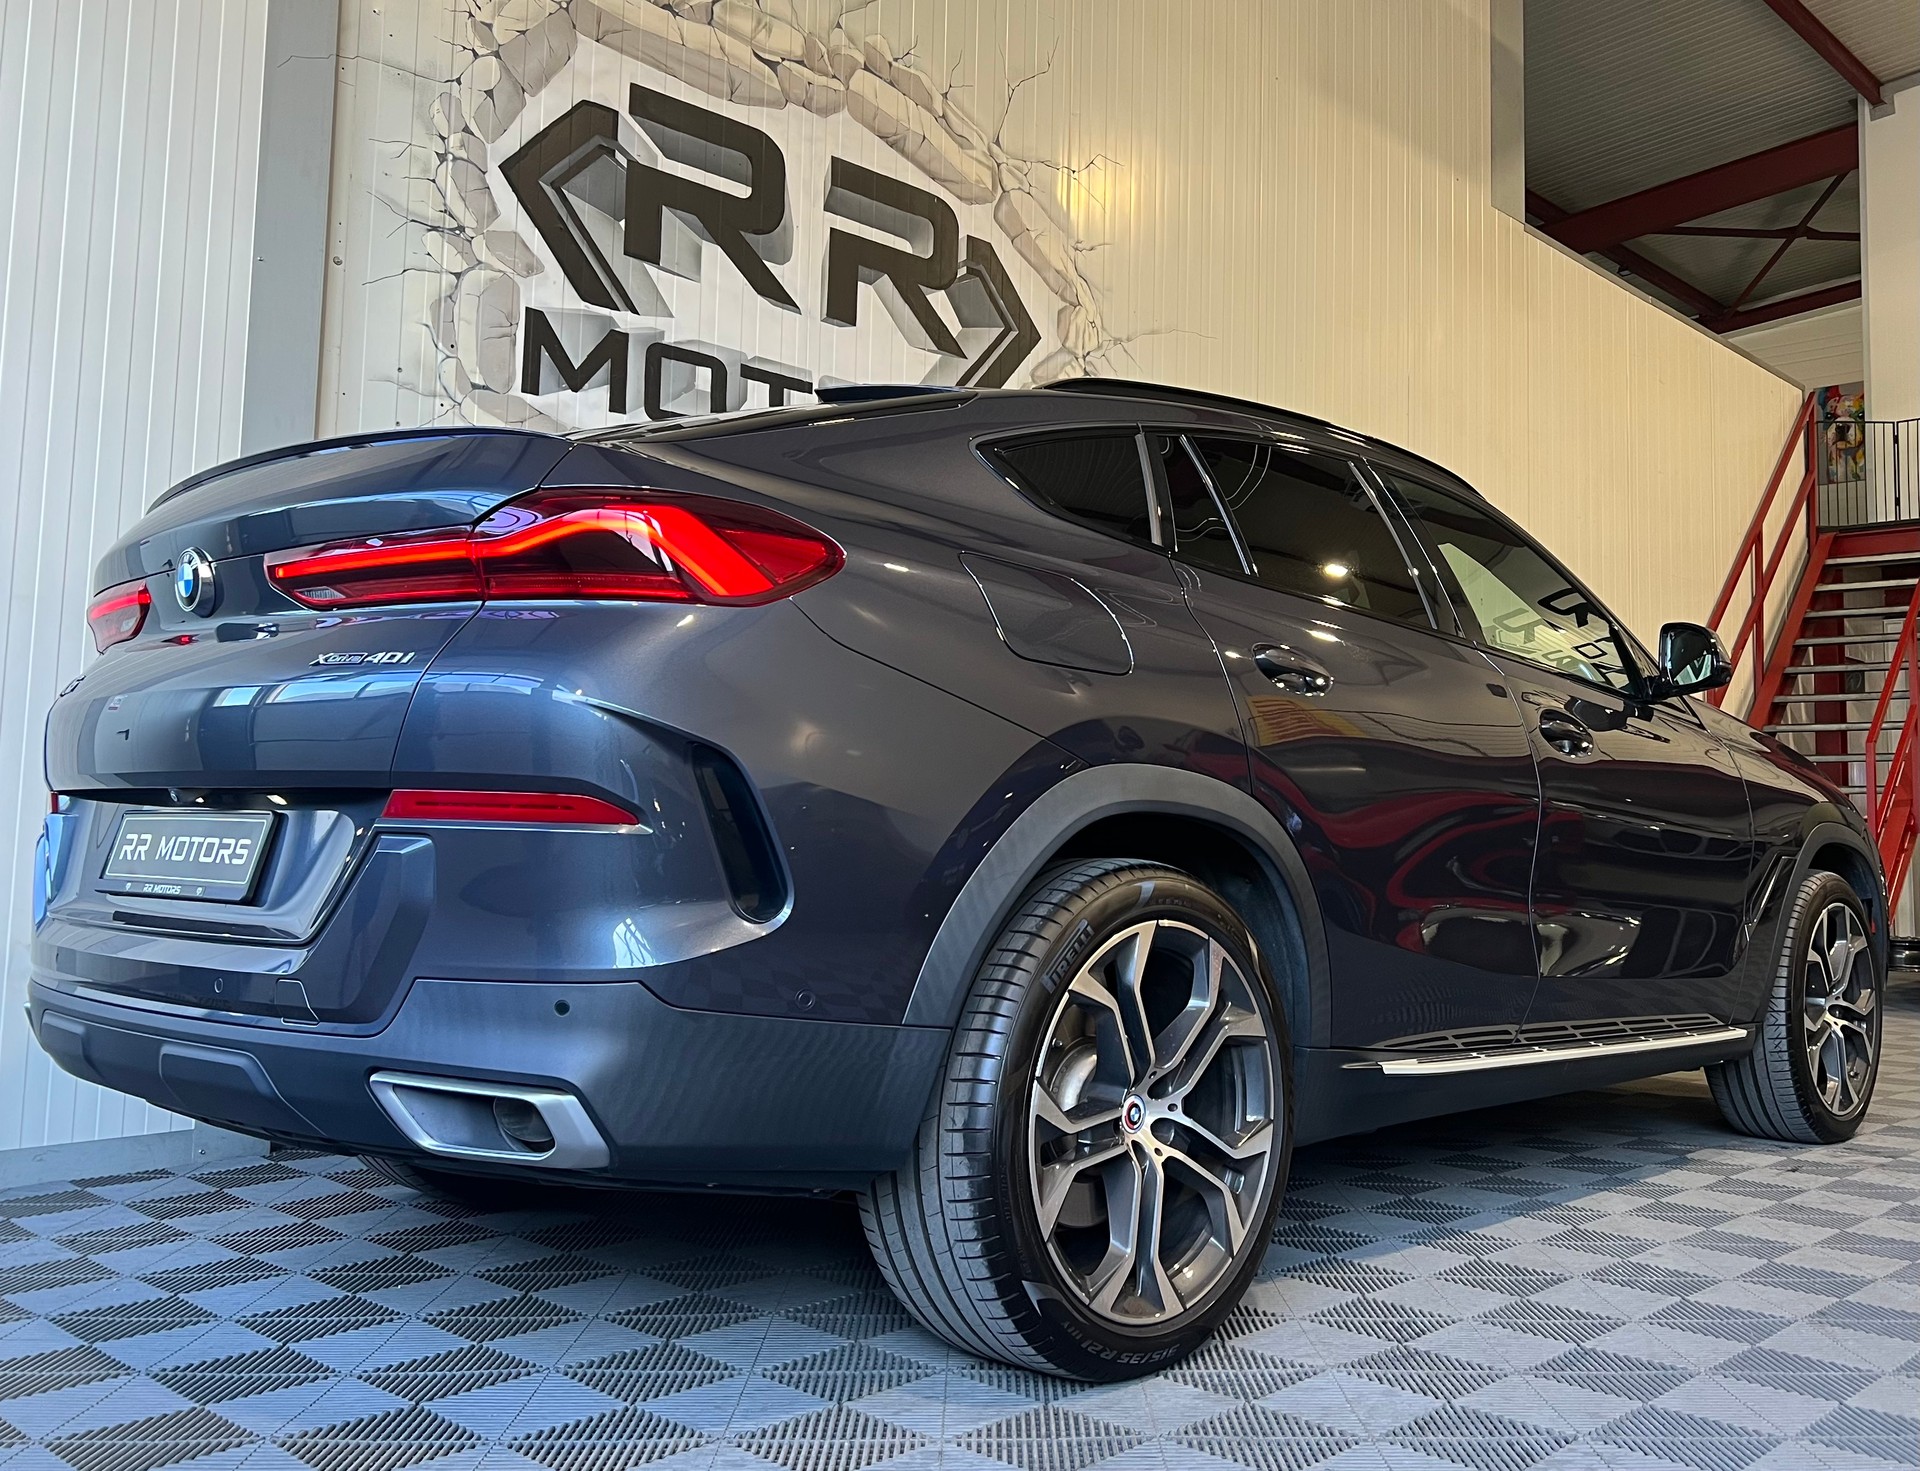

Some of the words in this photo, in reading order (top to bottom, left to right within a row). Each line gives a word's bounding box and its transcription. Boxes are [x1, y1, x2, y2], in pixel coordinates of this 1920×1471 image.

[520, 306, 814, 422] MOT
[119, 833, 153, 861] RR
[155, 836, 252, 865] MOTORS
[143, 883, 154, 893] RR
[153, 884, 182, 895] MOTORS
[1040, 918, 1096, 994] PIRELLI
[1080, 1339, 1118, 1361] R21
